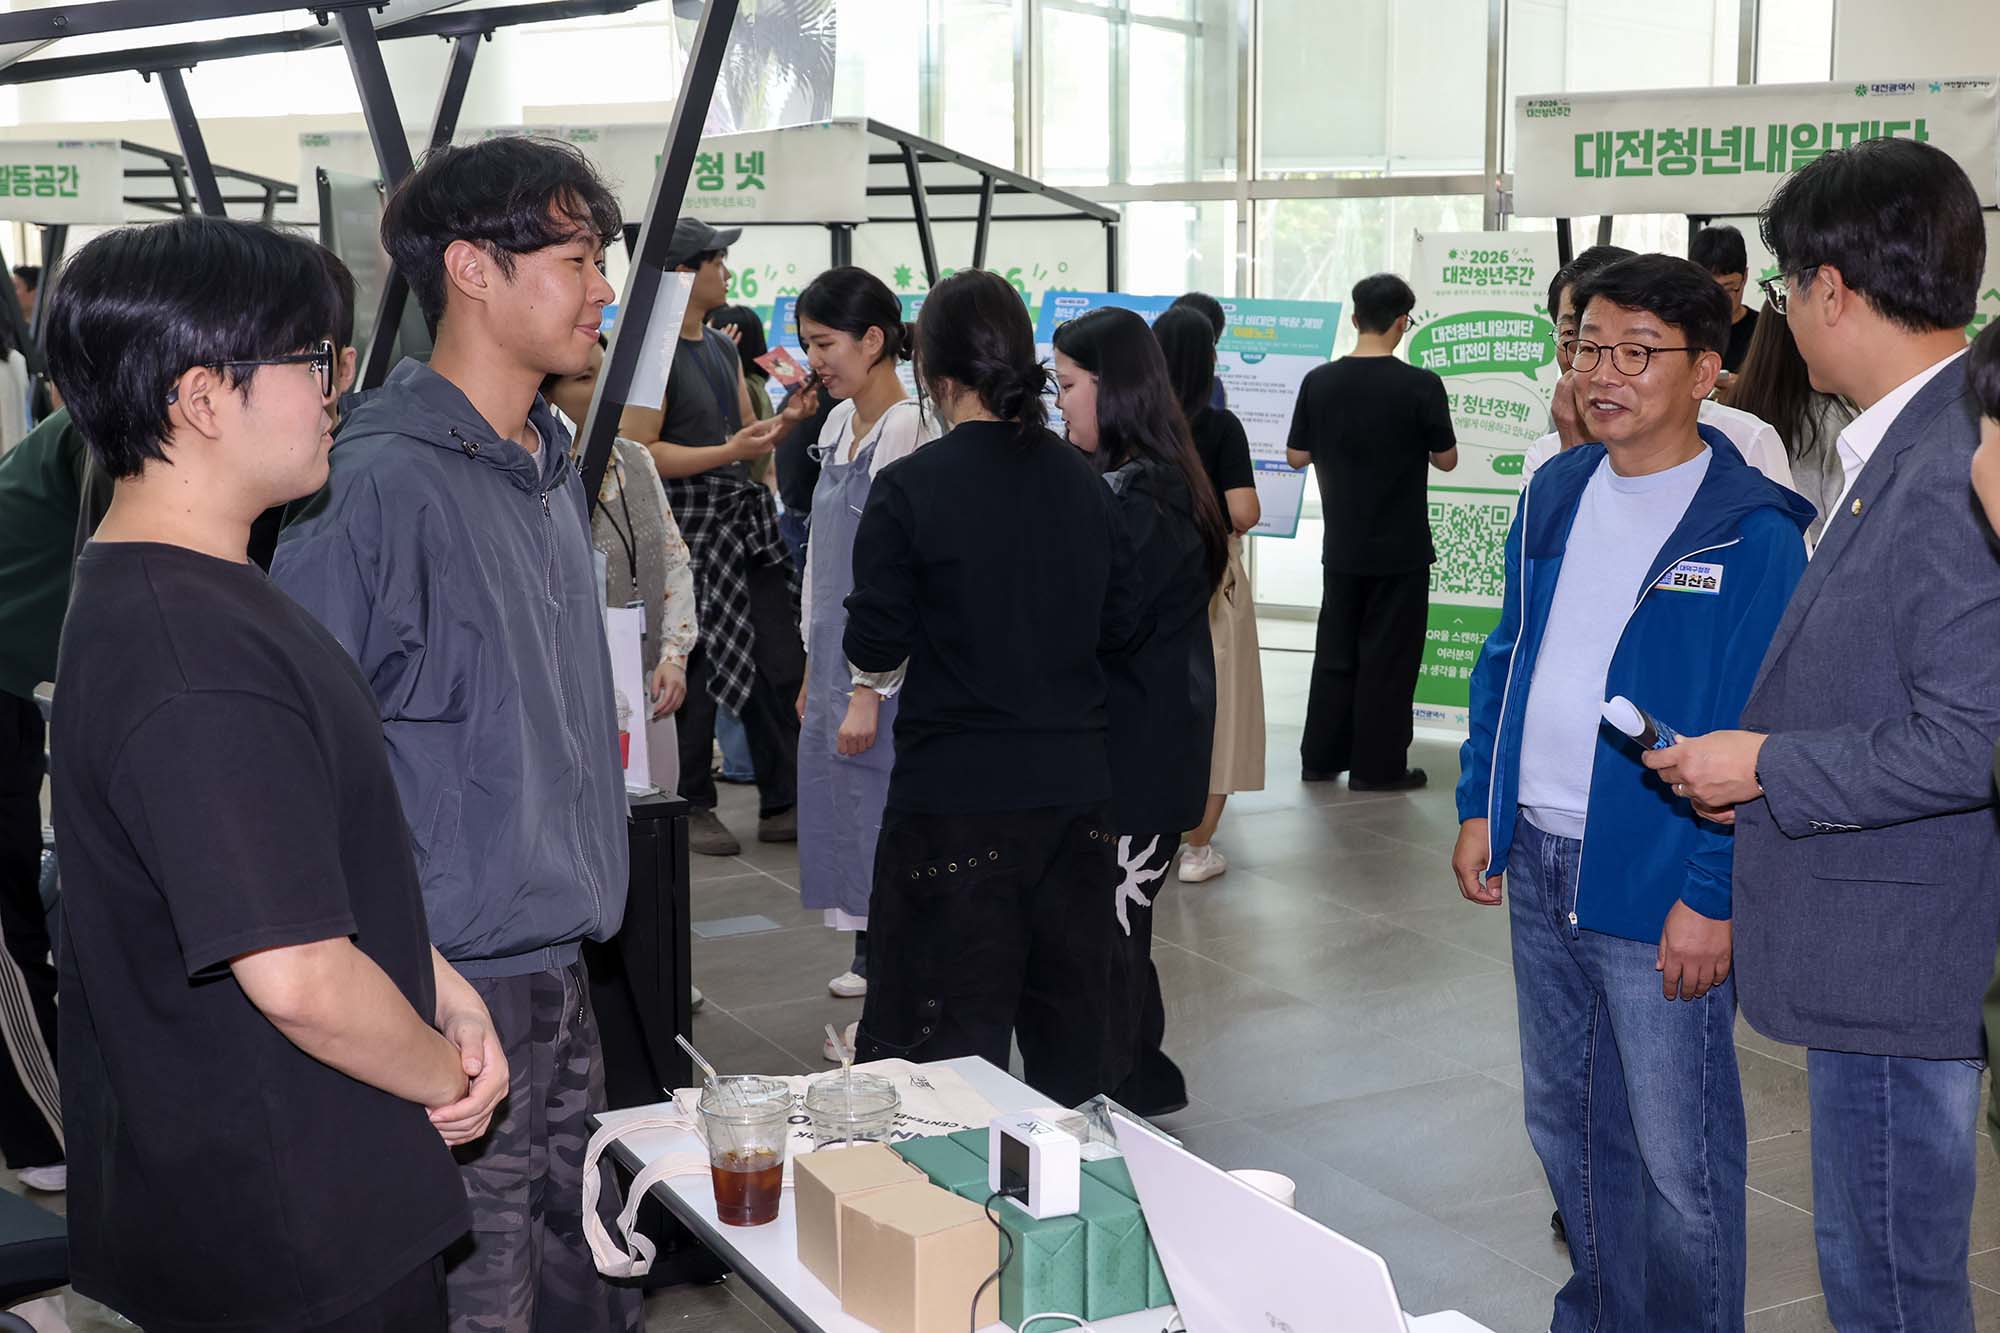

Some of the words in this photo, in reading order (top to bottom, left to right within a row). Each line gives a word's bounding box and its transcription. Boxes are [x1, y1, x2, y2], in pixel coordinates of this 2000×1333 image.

[1871, 82, 1915, 93] 대전광역시
[656, 151, 765, 191] 청넷
[1470, 250, 1509, 264] 2026
[727, 268, 758, 299] 26
[1442, 265, 1535, 287] 대전청년주간
[1431, 320, 1535, 344] 대전청년내일재단
[1421, 346, 1451, 369] 지금,
[1452, 341, 1491, 364] 대전의
[1493, 340, 1545, 363] 청년정책
[1447, 394, 1459, 413] 전
[1462, 394, 1531, 422] 청년정책!
[1436, 647, 1474, 662] 여러분의
